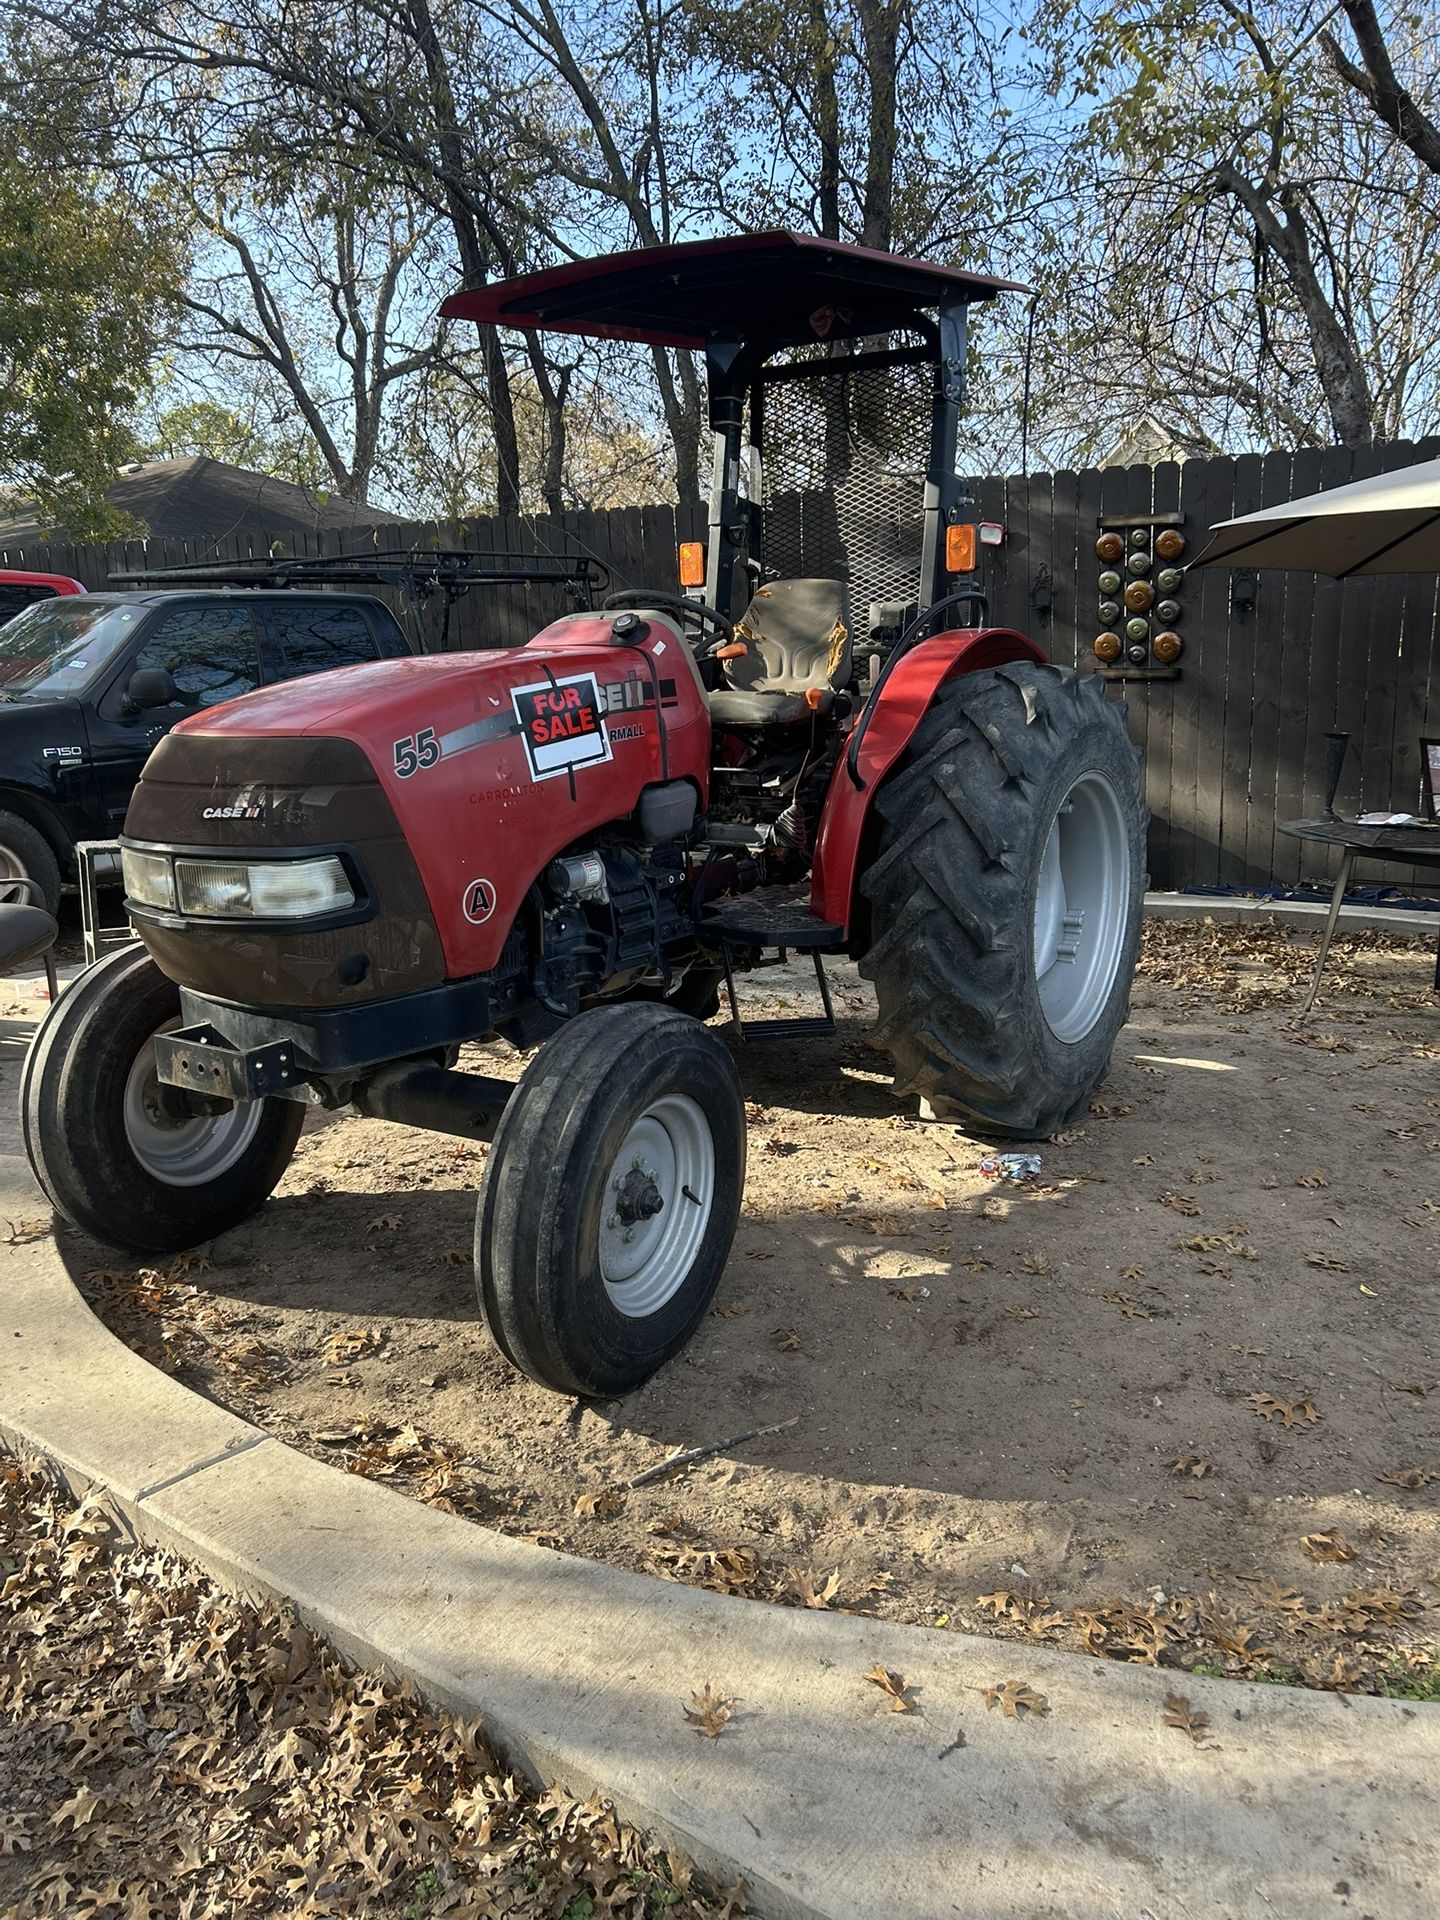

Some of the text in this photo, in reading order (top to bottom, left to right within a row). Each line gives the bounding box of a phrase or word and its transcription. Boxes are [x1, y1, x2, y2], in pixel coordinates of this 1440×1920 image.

[533, 688, 582, 716] FOR
[532, 708, 595, 743] SALE
[609, 725, 645, 742] RMALL
[393, 726, 440, 778] 55
[469, 784, 544, 804] CARROLLTON
[203, 807, 244, 818] CASE
[469, 885, 490, 915] A
